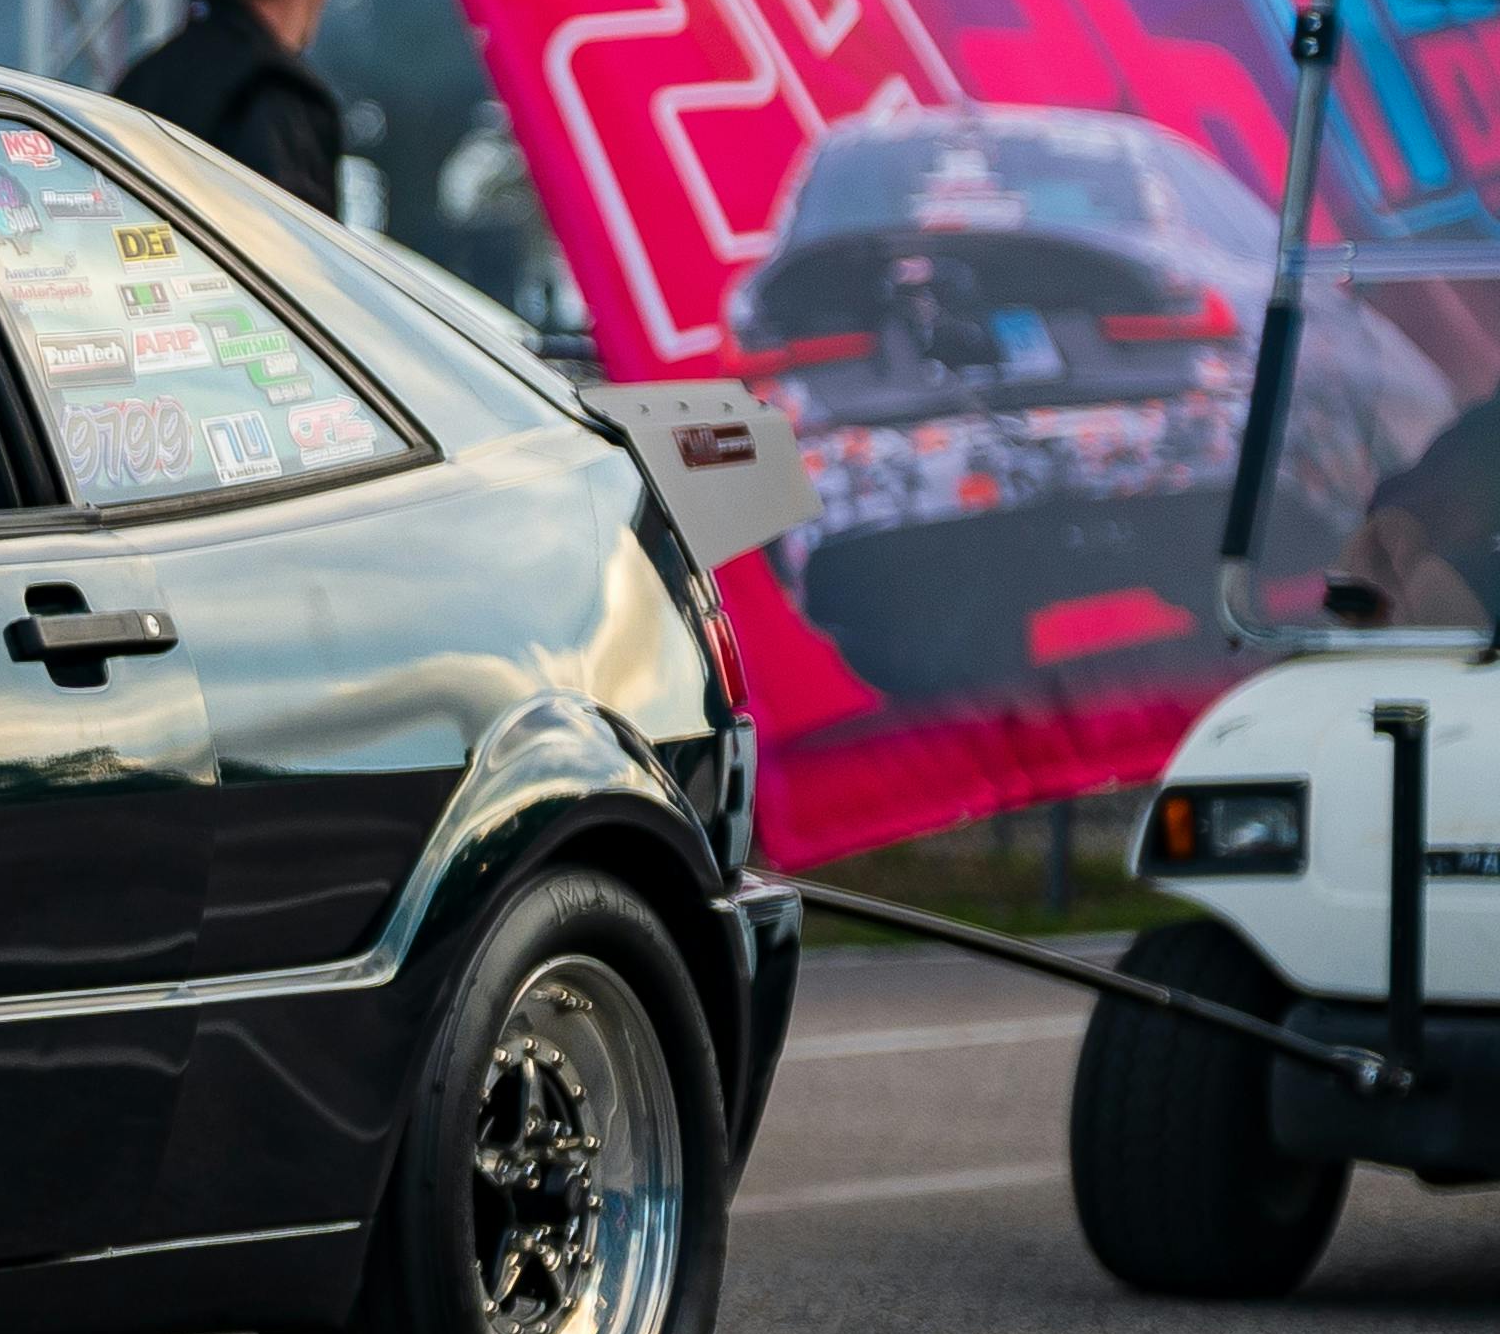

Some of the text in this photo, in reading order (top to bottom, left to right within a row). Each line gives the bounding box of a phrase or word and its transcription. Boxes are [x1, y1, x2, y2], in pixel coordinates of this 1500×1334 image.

[2, 131, 53, 157] MSD
[43, 342, 126, 365] FuelTech
[136, 328, 198, 355] ARP
[56, 396, 193, 484] 9799
